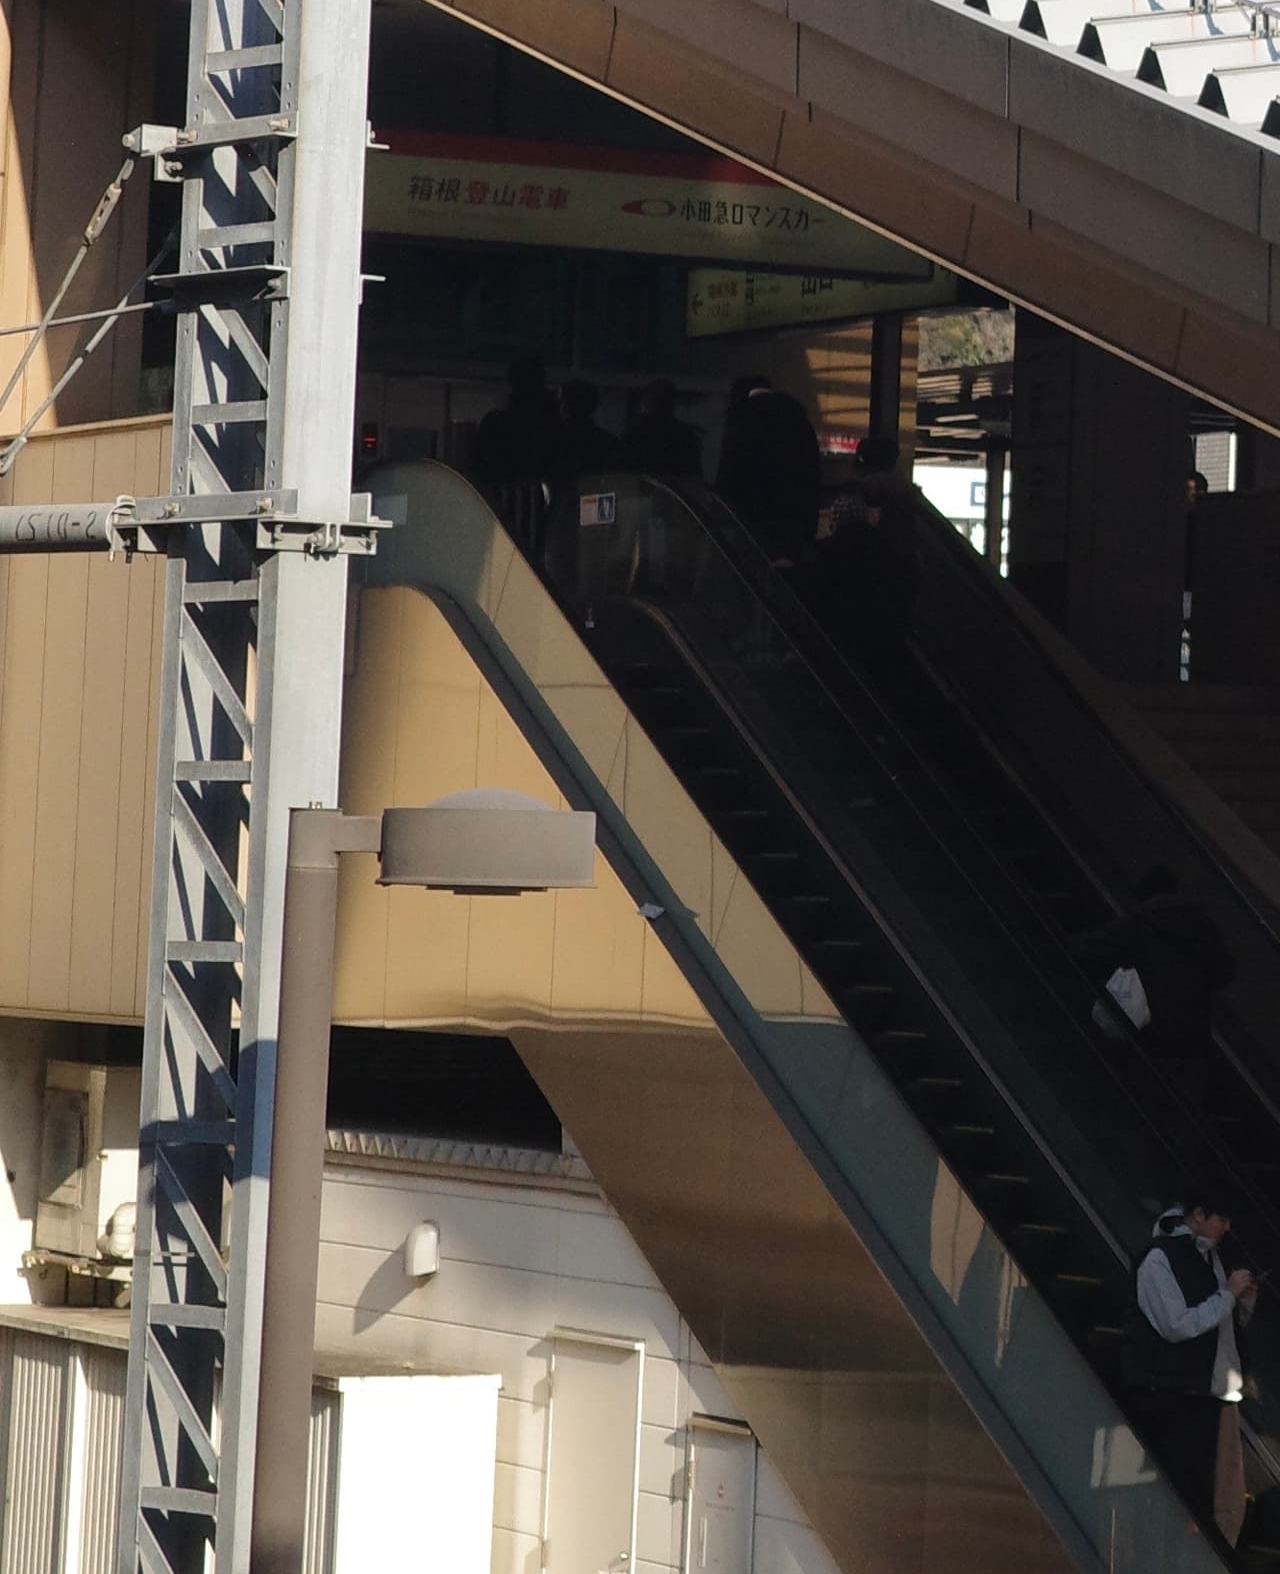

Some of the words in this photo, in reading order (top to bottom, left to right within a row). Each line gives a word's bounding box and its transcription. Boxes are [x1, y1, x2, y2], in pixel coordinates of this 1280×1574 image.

[407, 176, 571, 212] 箱根登山電車
[679, 196, 825, 232] 小田急ロマンスカー
